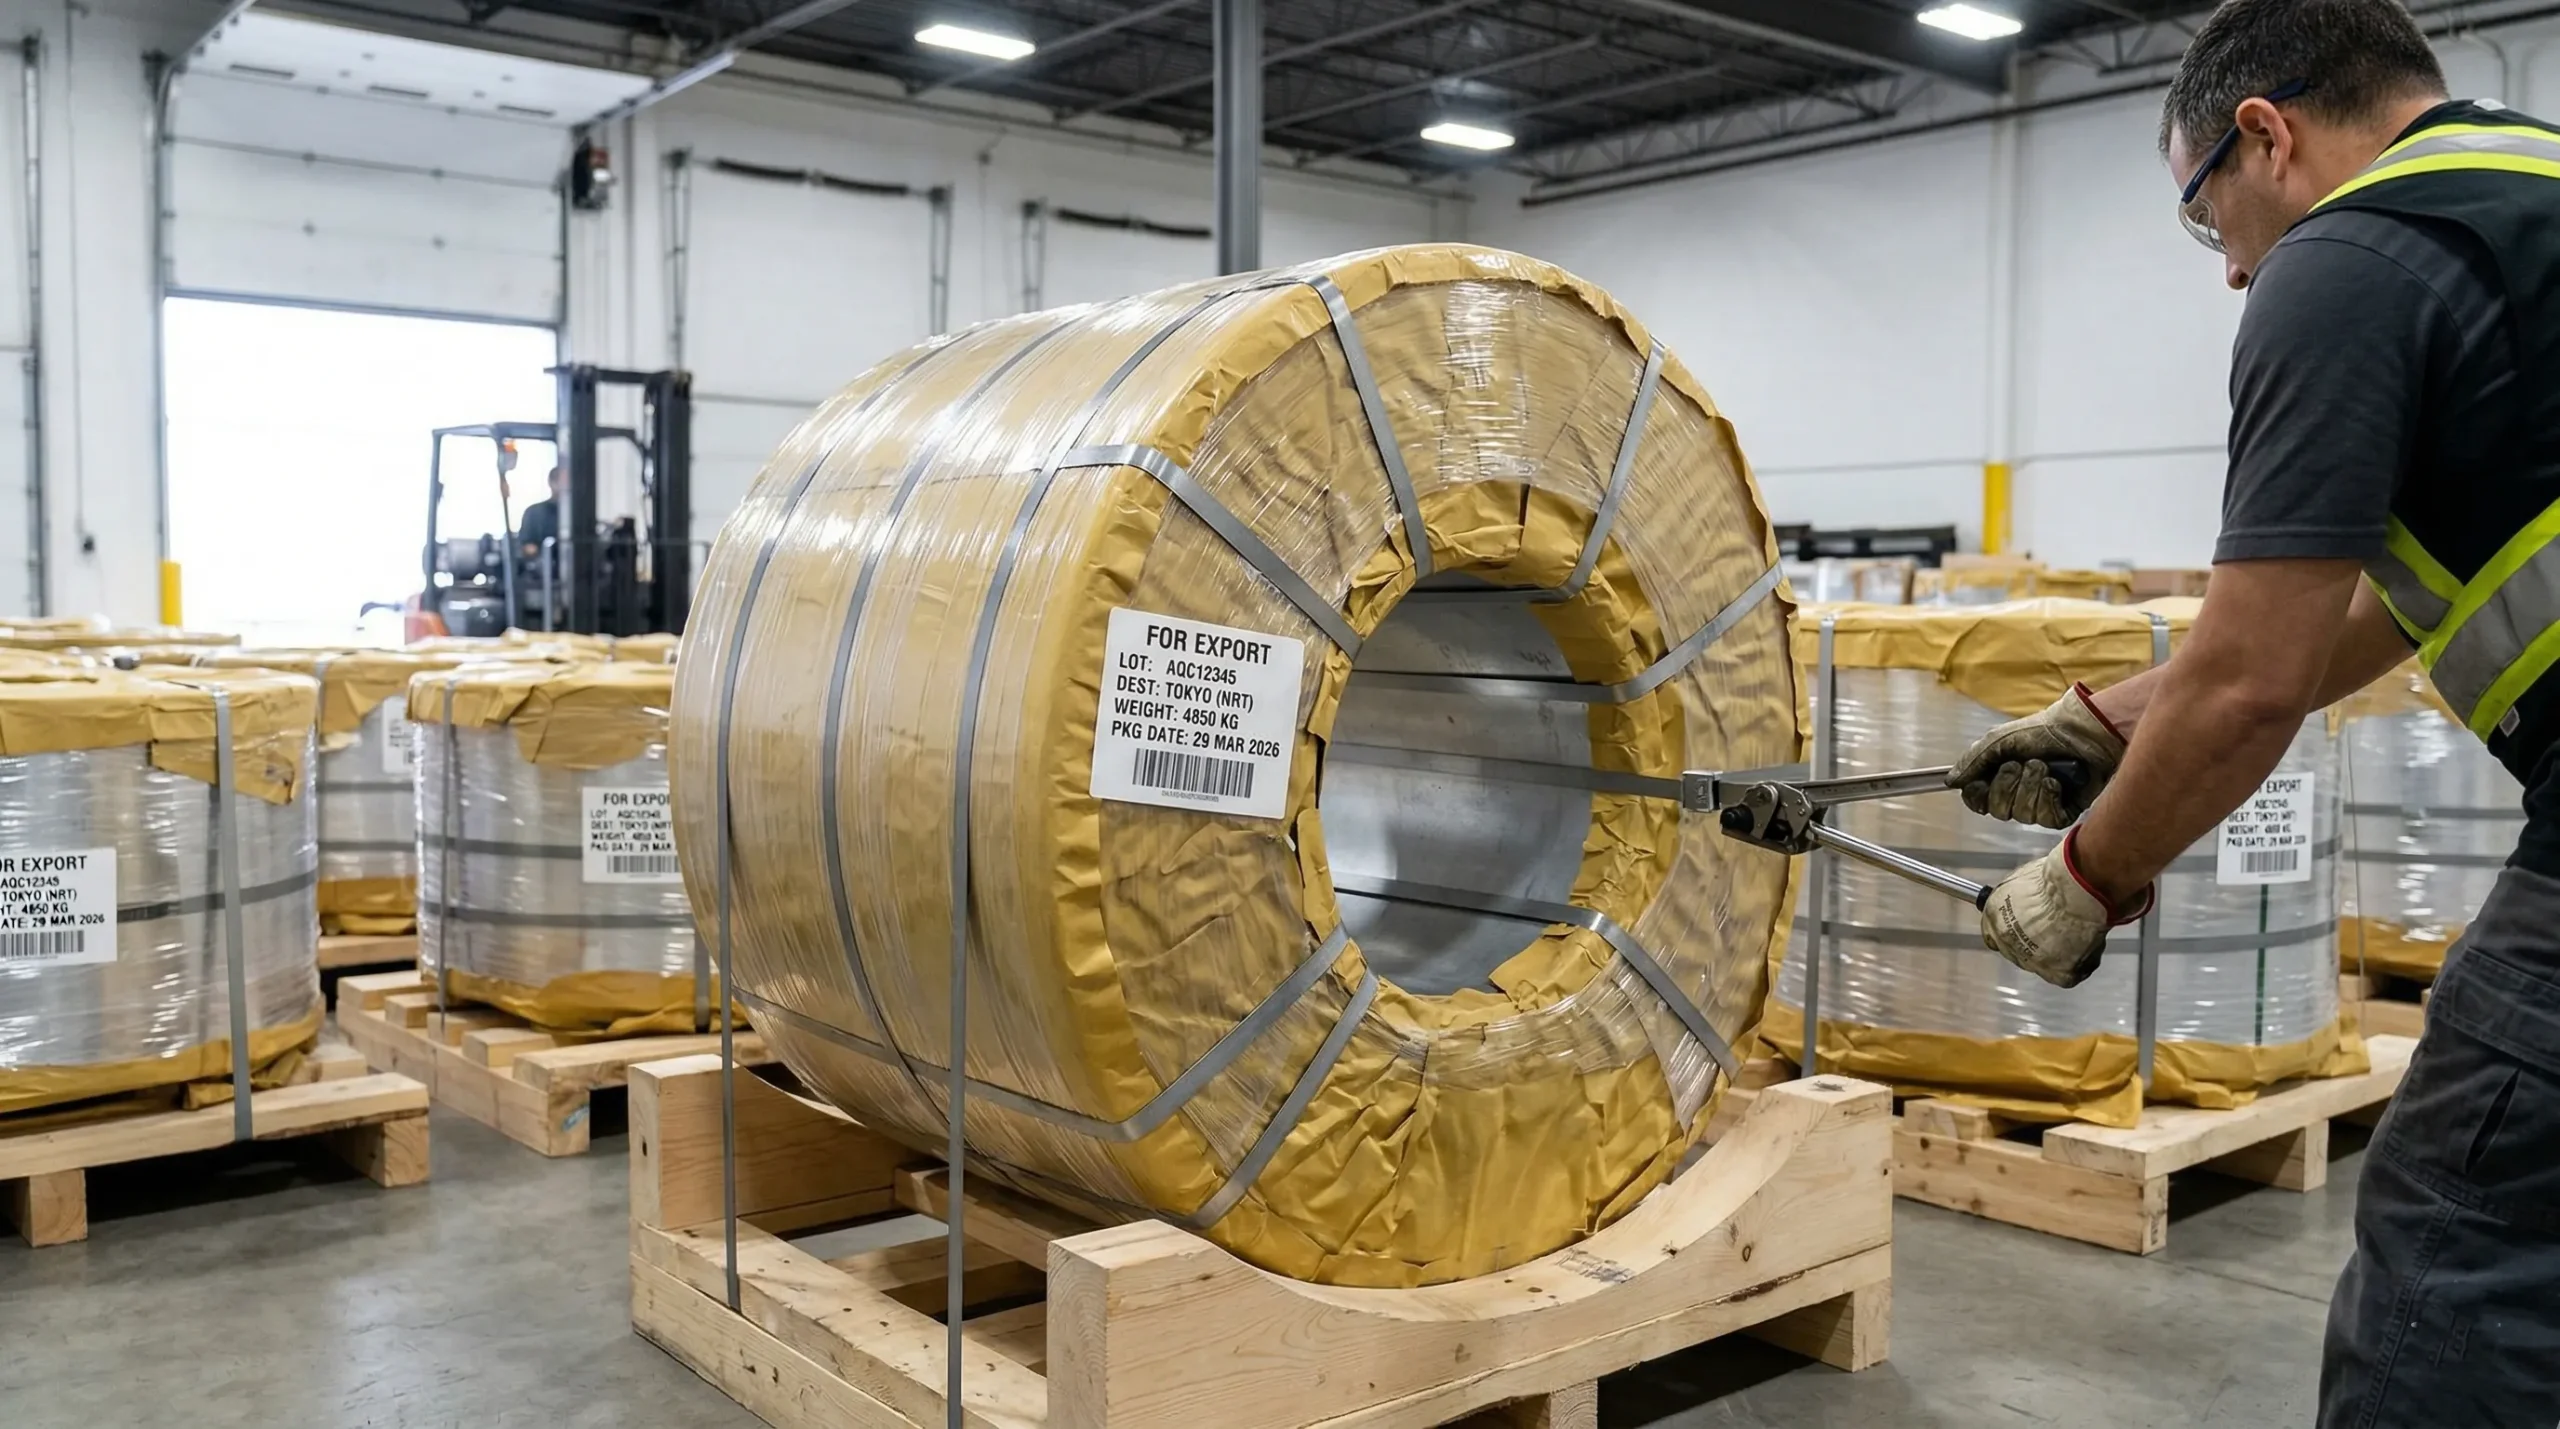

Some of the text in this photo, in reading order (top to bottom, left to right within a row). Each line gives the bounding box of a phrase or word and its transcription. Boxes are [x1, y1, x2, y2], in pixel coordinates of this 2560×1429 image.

[1147, 625, 1271, 664] FOR EXPORT
[1119, 652, 1236, 685] LOT: AQC12345
[1117, 675, 1254, 713] DEST: TOKYO (NRT)
[1114, 698, 1239, 730] WEIGHT: 4850 KG
[1111, 721, 1280, 758] PKG DATE: 29 MAR 2026
[604, 793, 628, 805] FOR
[22, 855, 87, 872] EXPORT
[2, 889, 41, 902] TOKYO
[53, 902, 68, 914] KG
[79, 913, 105, 925] 2026
